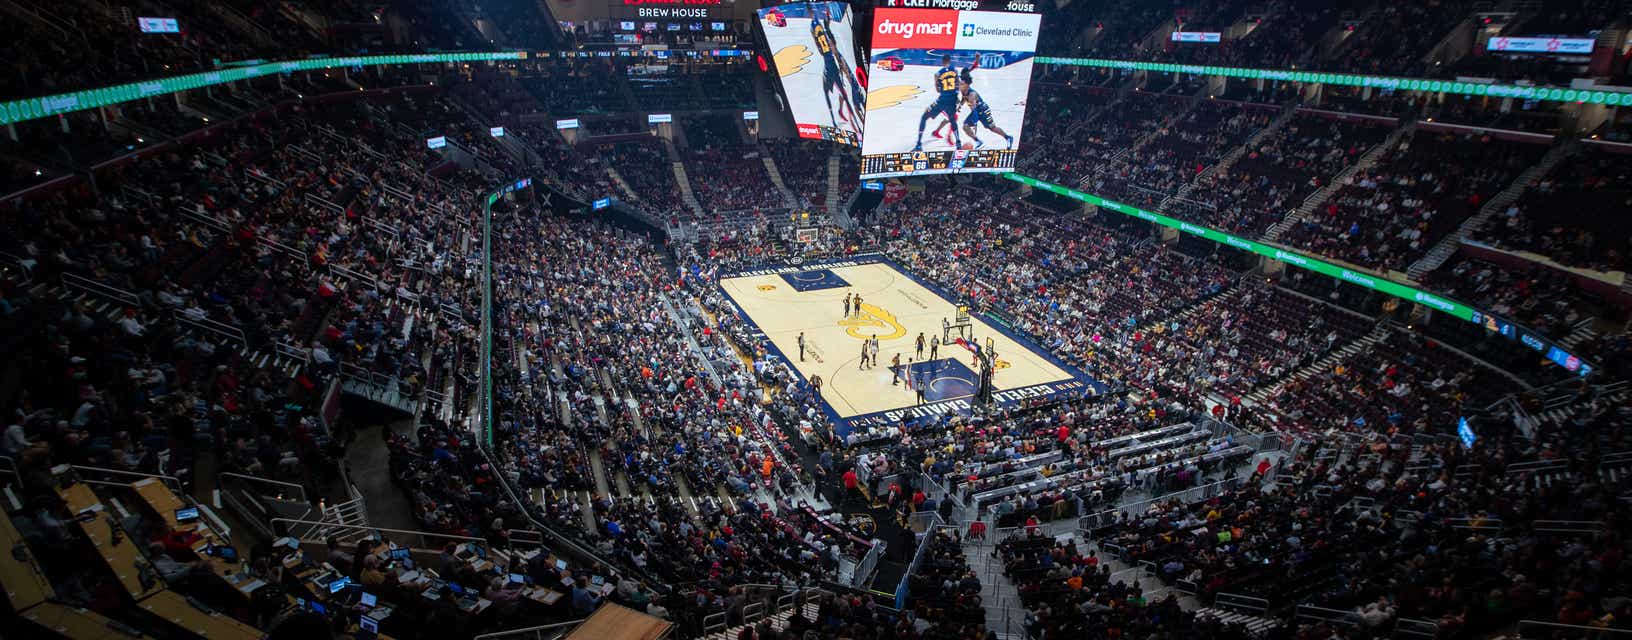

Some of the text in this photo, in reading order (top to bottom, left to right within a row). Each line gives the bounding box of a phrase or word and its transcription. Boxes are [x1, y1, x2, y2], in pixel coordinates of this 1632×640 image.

[639, 8, 708, 17] BREW HOUSE
[932, 0, 979, 11] Mortgage
[878, 19, 953, 38] drug mart
[975, 26, 1033, 37] Cleveland Clinic
[941, 77, 956, 91] 13
[916, 161, 926, 170] 66
[740, 261, 858, 277] CLEVELAND CAVALIERS
[1342, 269, 1375, 287] Welcome
[993, 384, 1056, 403] CLEVELA
